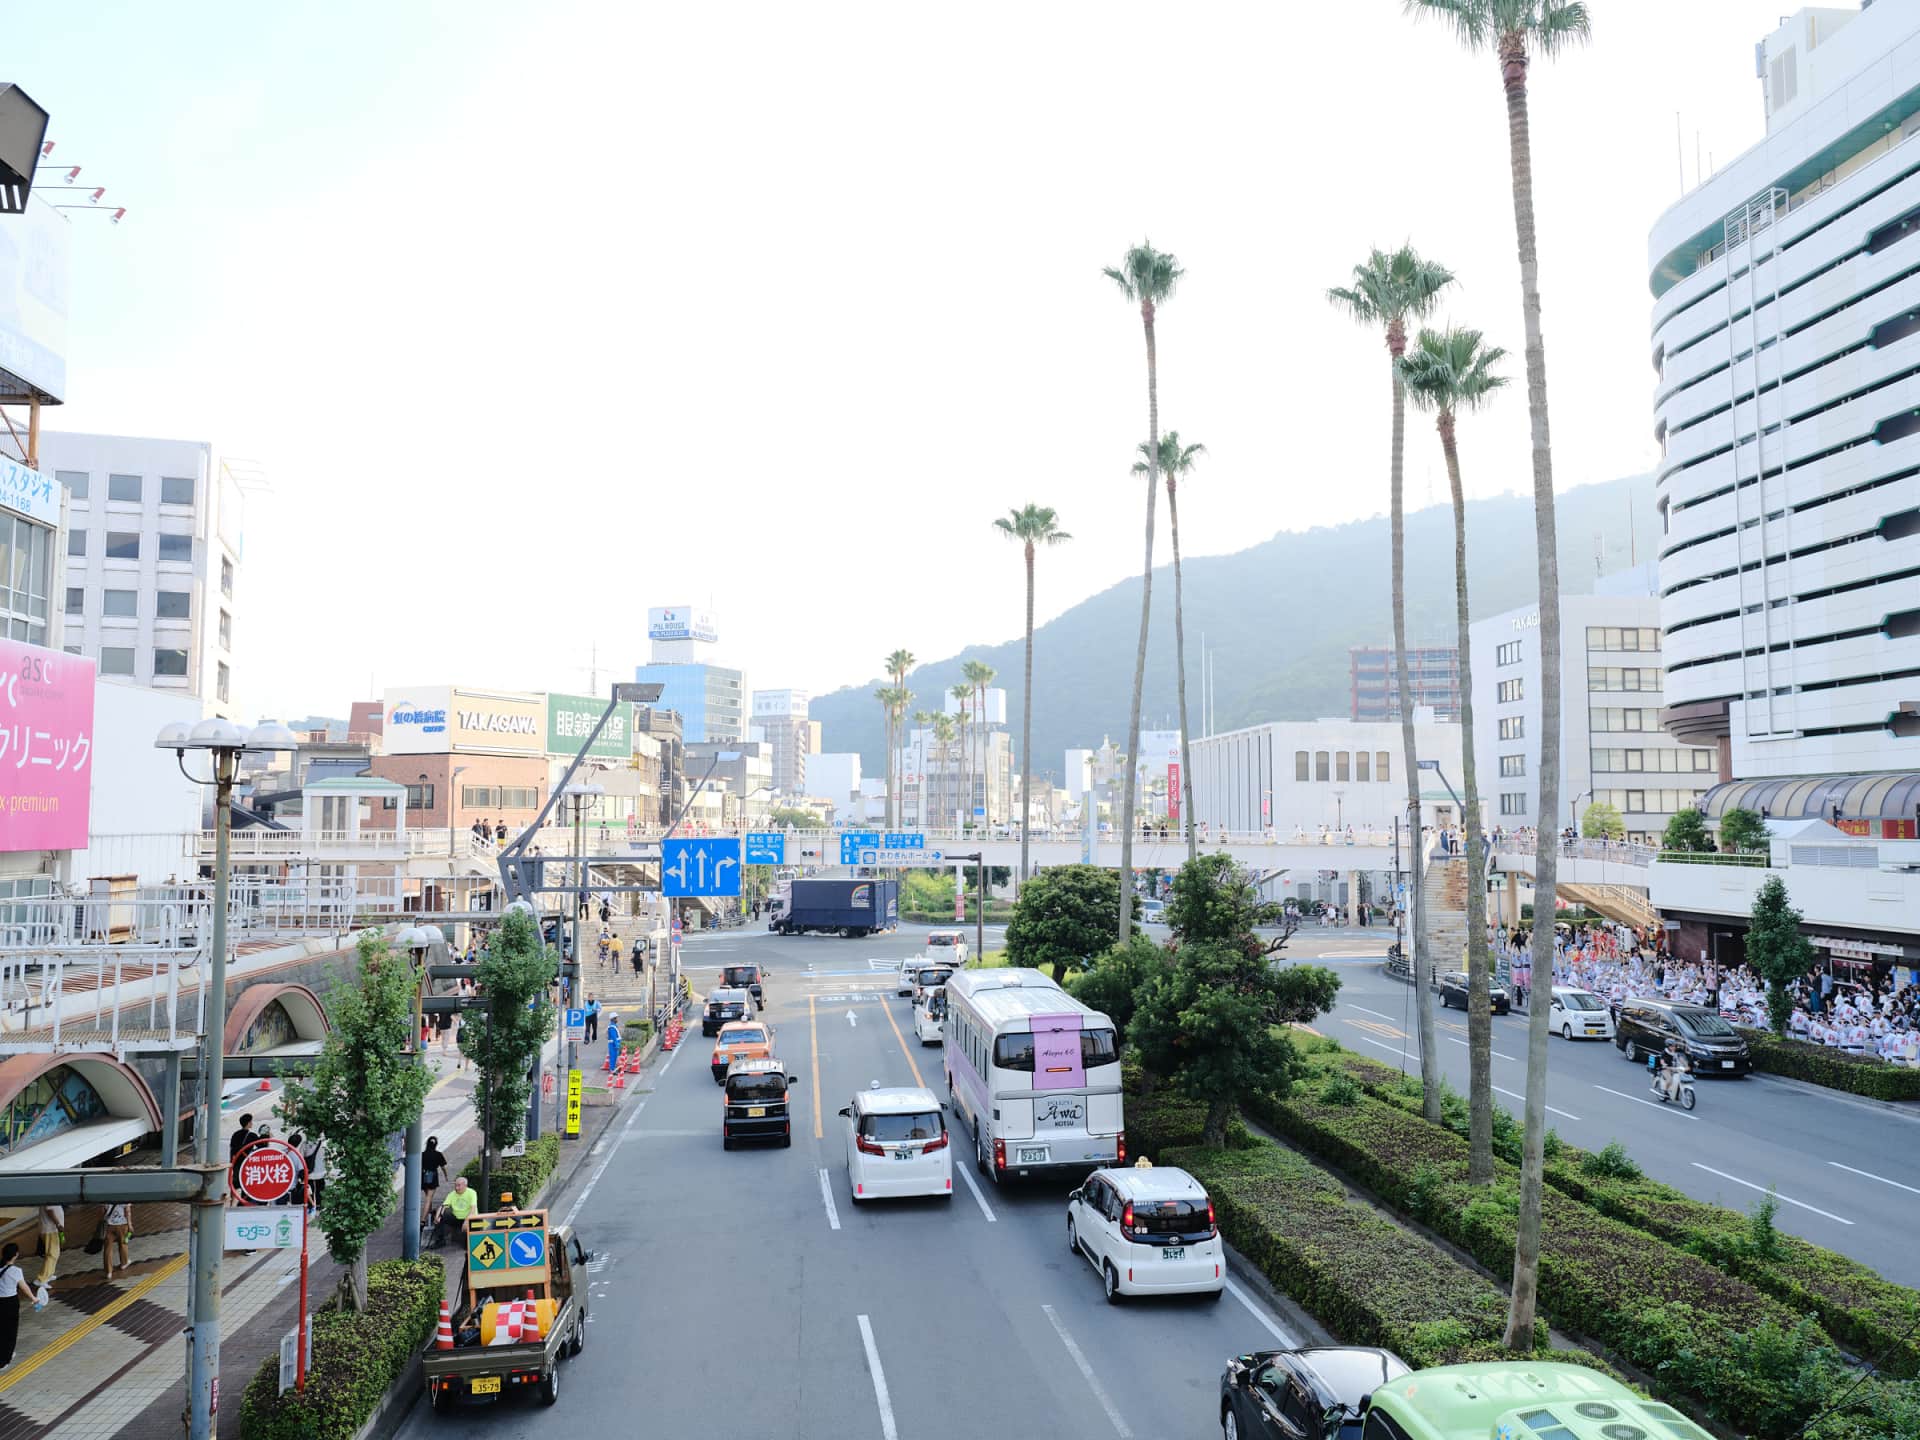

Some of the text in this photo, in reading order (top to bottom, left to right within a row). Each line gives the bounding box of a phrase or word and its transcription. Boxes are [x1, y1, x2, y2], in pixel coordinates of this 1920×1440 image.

[0, 466, 53, 503] スタジオ
[22, 656, 52, 684] asc
[458, 711, 537, 734] TAKAGAWA
[571, 1012, 581, 1025] P
[569, 1087, 579, 1122] 工事中
[1038, 1105, 1084, 1121] Awa
[246, 1163, 290, 1186] 消火栓
[237, 1225, 271, 1241] モンダミン
